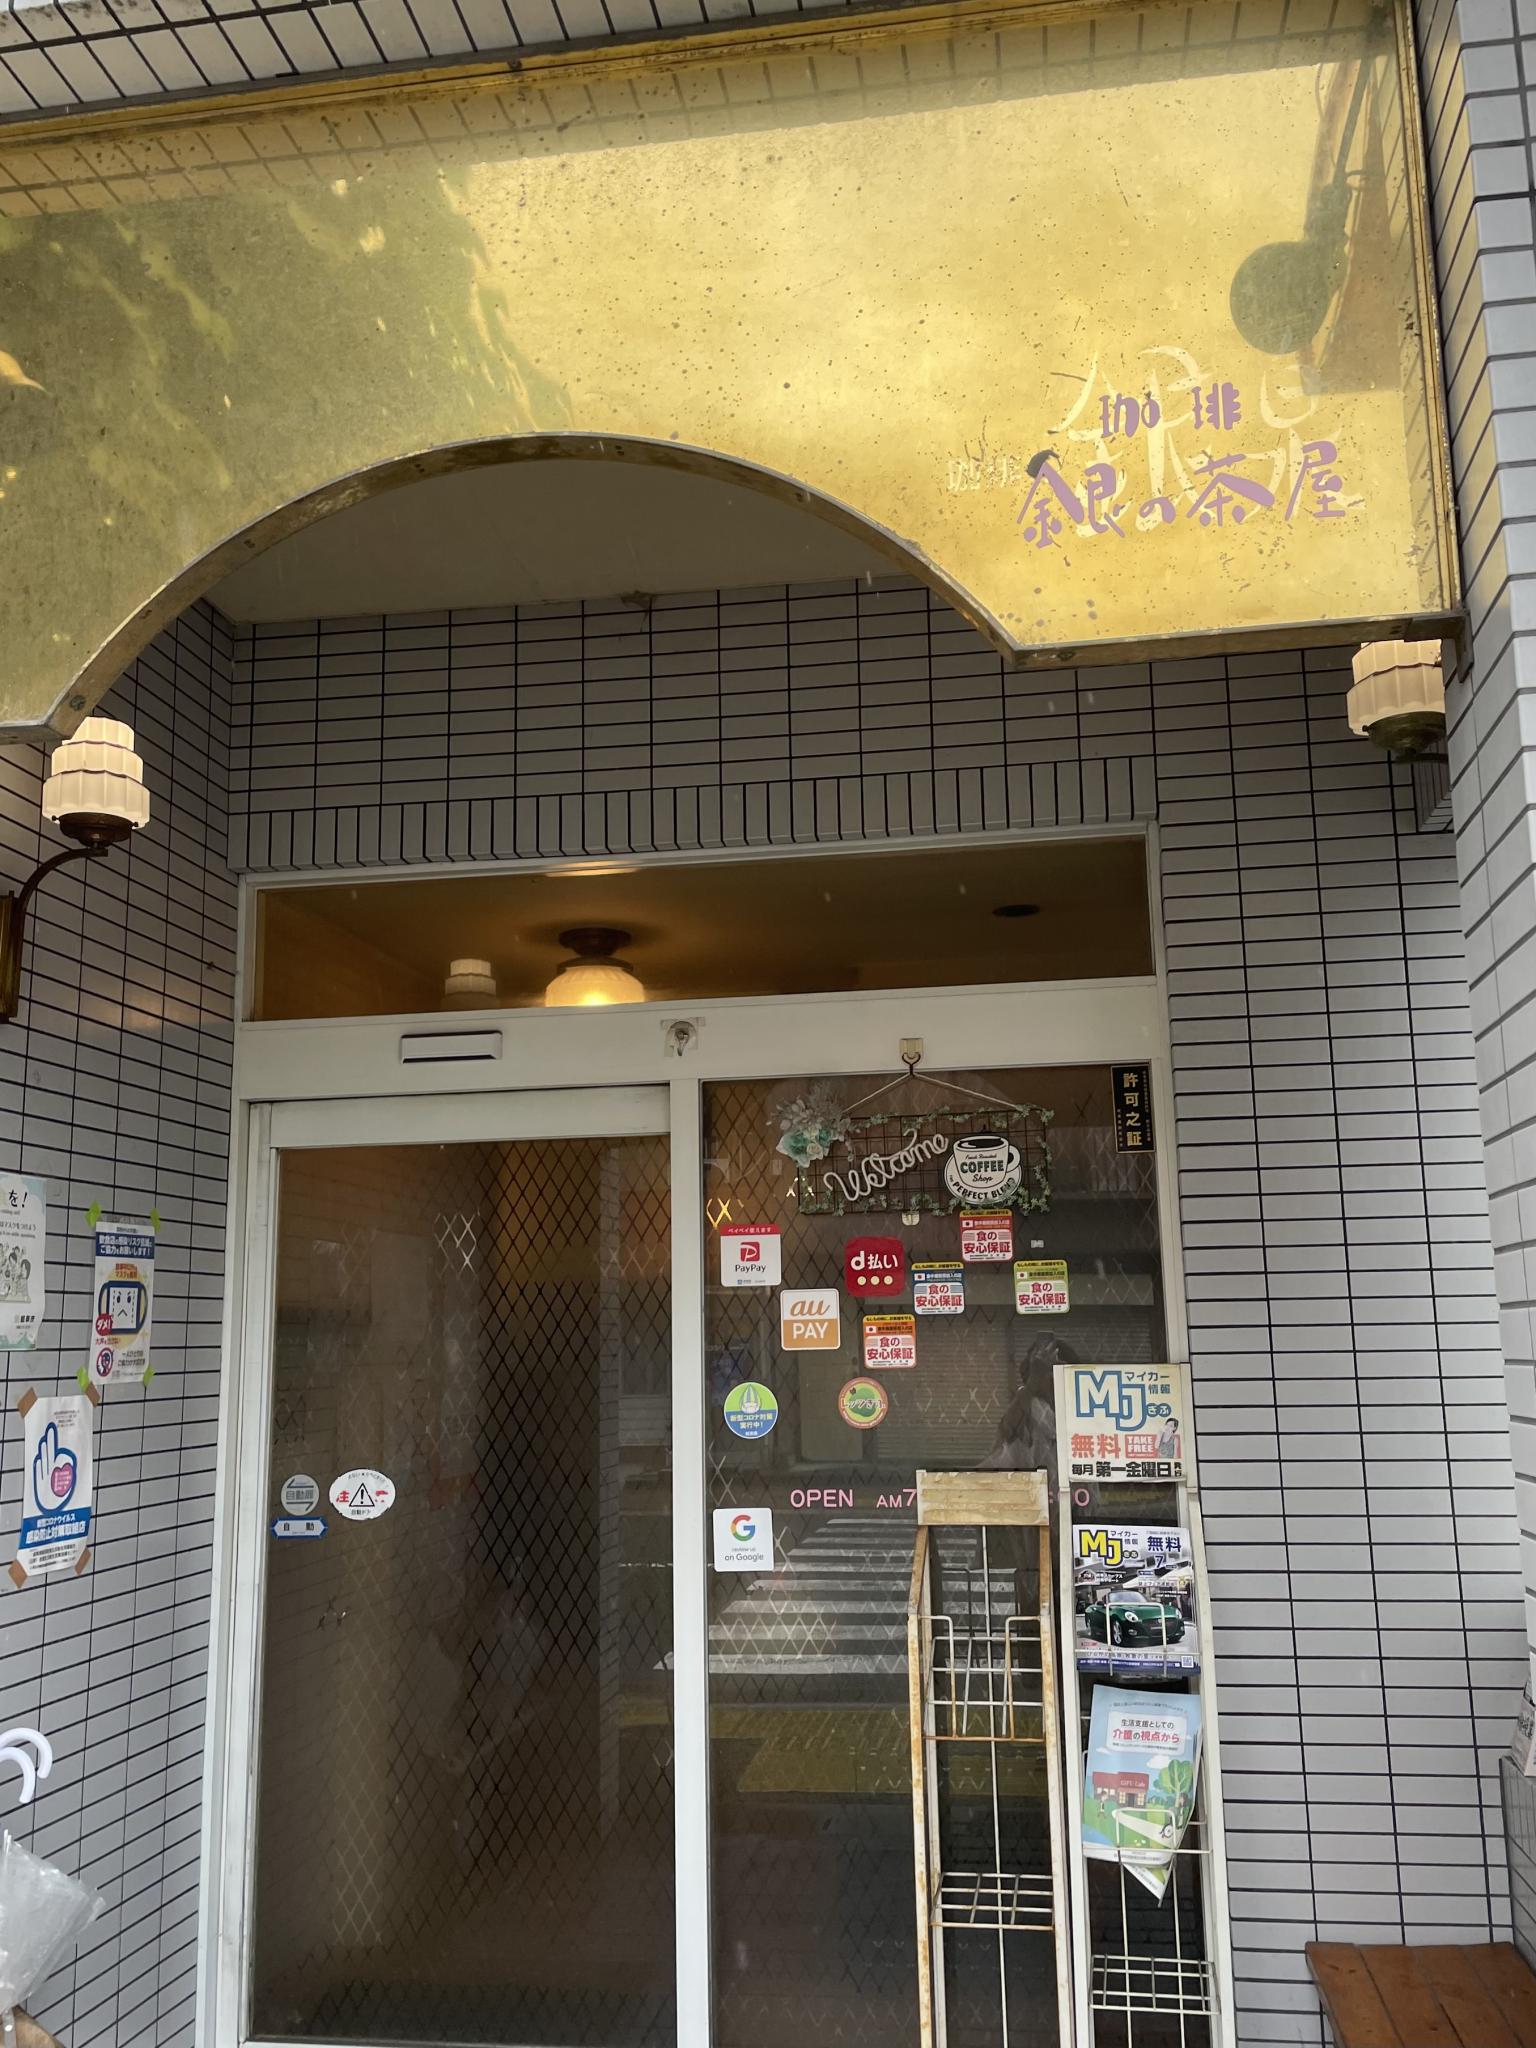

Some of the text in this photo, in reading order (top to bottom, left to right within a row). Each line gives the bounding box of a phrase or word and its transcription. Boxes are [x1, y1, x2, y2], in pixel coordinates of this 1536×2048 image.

[1016, 441, 1346, 549] 銀の茶屋
[1123, 1072, 1142, 1147] 許可之証
[823, 1128, 949, 1201] Welcome
[960, 1160, 1004, 1173] COFFEE
[972, 1174, 994, 1183] Shop
[952, 1181, 989, 1200] PERFECT
[976, 1231, 997, 1242] 食の
[963, 1241, 1011, 1254] 安心保証
[850, 1250, 898, 1271] d払い
[735, 1264, 766, 1272] PayPay
[928, 1284, 949, 1295] 食の
[1031, 1282, 1053, 1293] 食の
[915, 1294, 963, 1307] 安心保証
[1018, 1293, 1066, 1306] 安心保証
[790, 1300, 831, 1317] au
[793, 1322, 829, 1339] PAY
[879, 1337, 900, 1347] 食の
[867, 1347, 914, 1360] 安心保証
[1124, 1371, 1170, 1381] マイカー
[1148, 1384, 1171, 1394] 情報
[1074, 1370, 1148, 1431] MJ
[1148, 1405, 1170, 1415] ぎふ
[1071, 1433, 1121, 1458] 無料
[1127, 1436, 1153, 1445] TAKE
[790, 1489, 853, 1508] OPEN
[1079, 1529, 1123, 1566] MJ
[1147, 1536, 1182, 1552] 無料
[736, 1553, 764, 1562] Google
